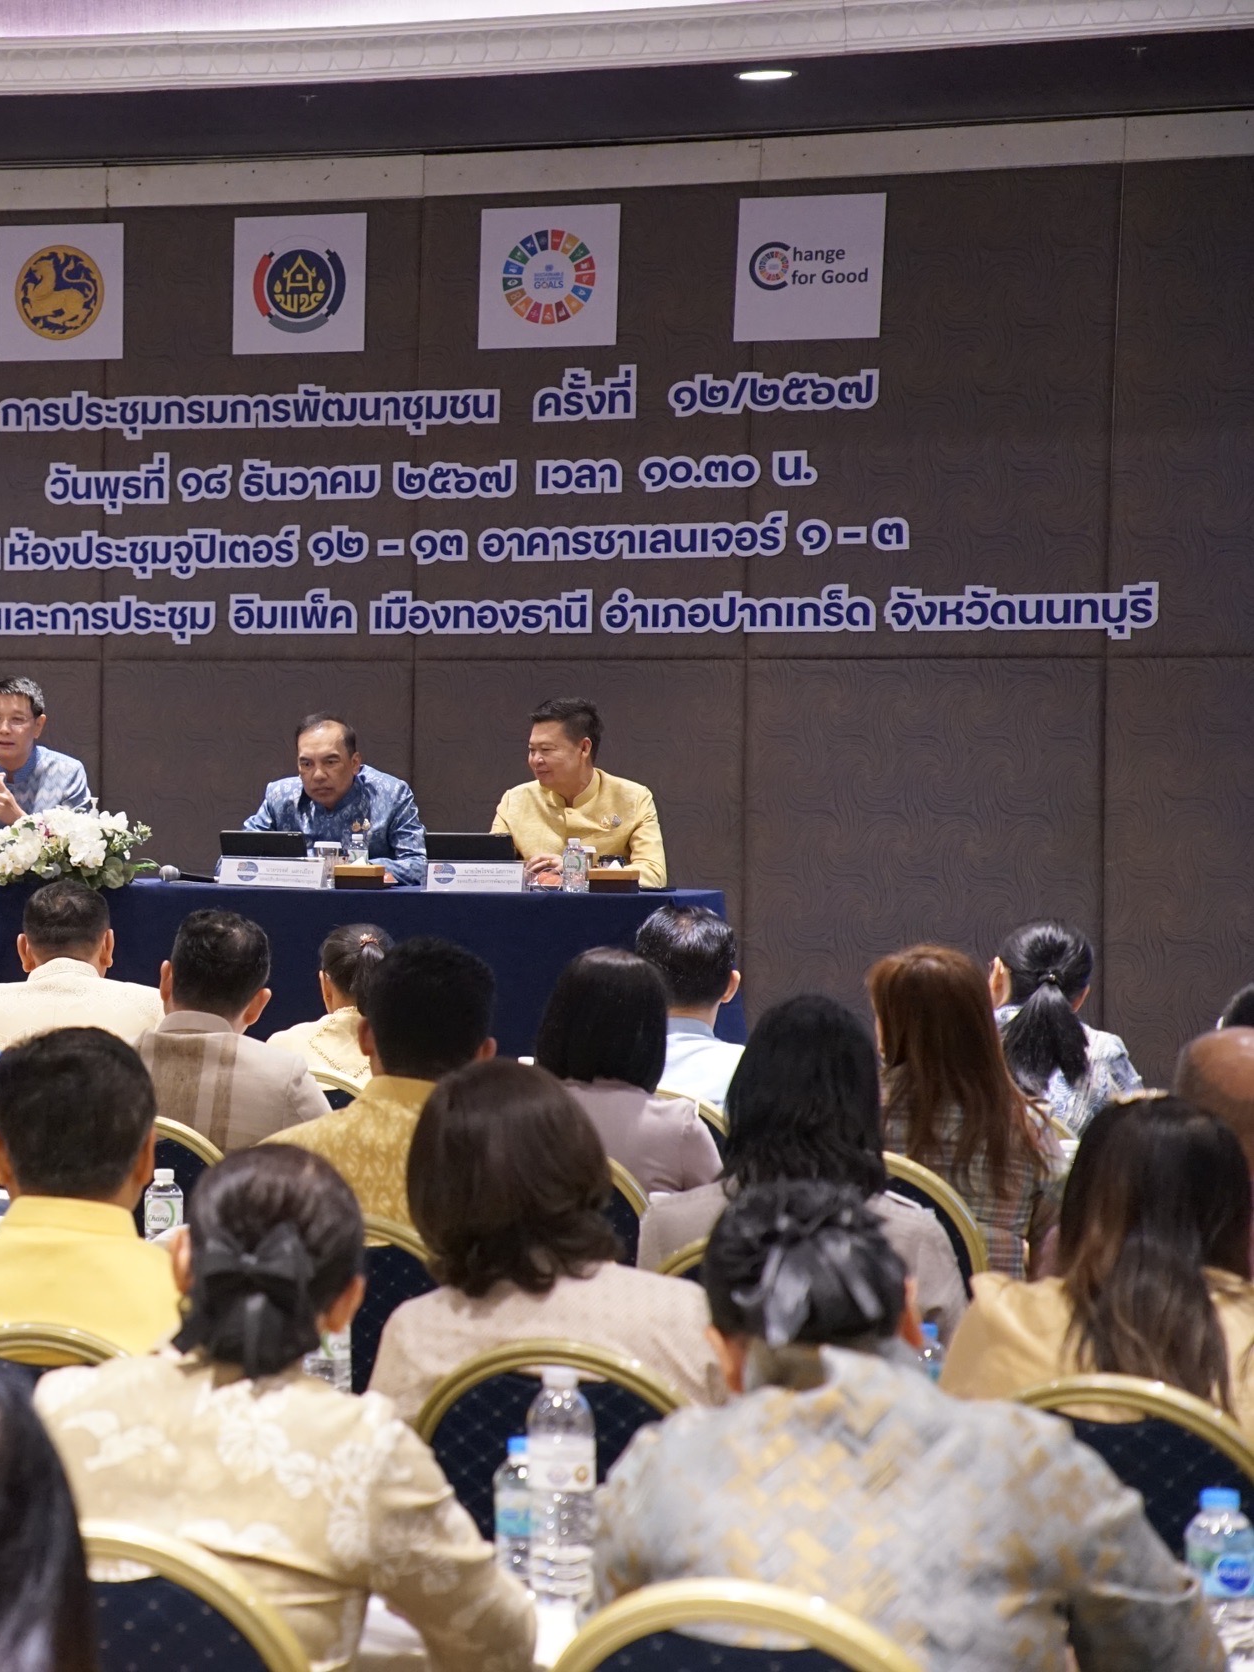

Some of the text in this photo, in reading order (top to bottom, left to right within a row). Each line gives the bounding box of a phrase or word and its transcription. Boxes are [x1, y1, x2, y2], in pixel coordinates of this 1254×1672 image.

[533, 281, 564, 290] GOALS
[791, 268, 869, 285] for Good
[0, 367, 876, 435] การประชุมกรมการพัฒนาชุมชน ครั้งที่ ๑๒/๒๕๖๗
[48, 454, 814, 511] วันพุธที่ ๑๘ ธันวาคม ๒๕๖๗ เวลา ๑๐.๓๐ น.
[7, 528, 297, 577] ห้องประชุมจูปิเตอร์
[310, 528, 366, 563] ๑๒
[413, 532, 465, 562] ๑๓
[481, 514, 785, 559] อาคารชาเลนเจอร์
[799, 522, 829, 552] ๑
[875, 520, 906, 547] ๓
[231, 591, 354, 631] อิมแพ็ค
[372, 592, 589, 632] เมืองทองธานี
[603, 587, 873, 631] อำเภอปากเกร็ด
[888, 585, 1155, 636] จังหวัดนนทบุรี
[147, 1214, 170, 1223] Chang
